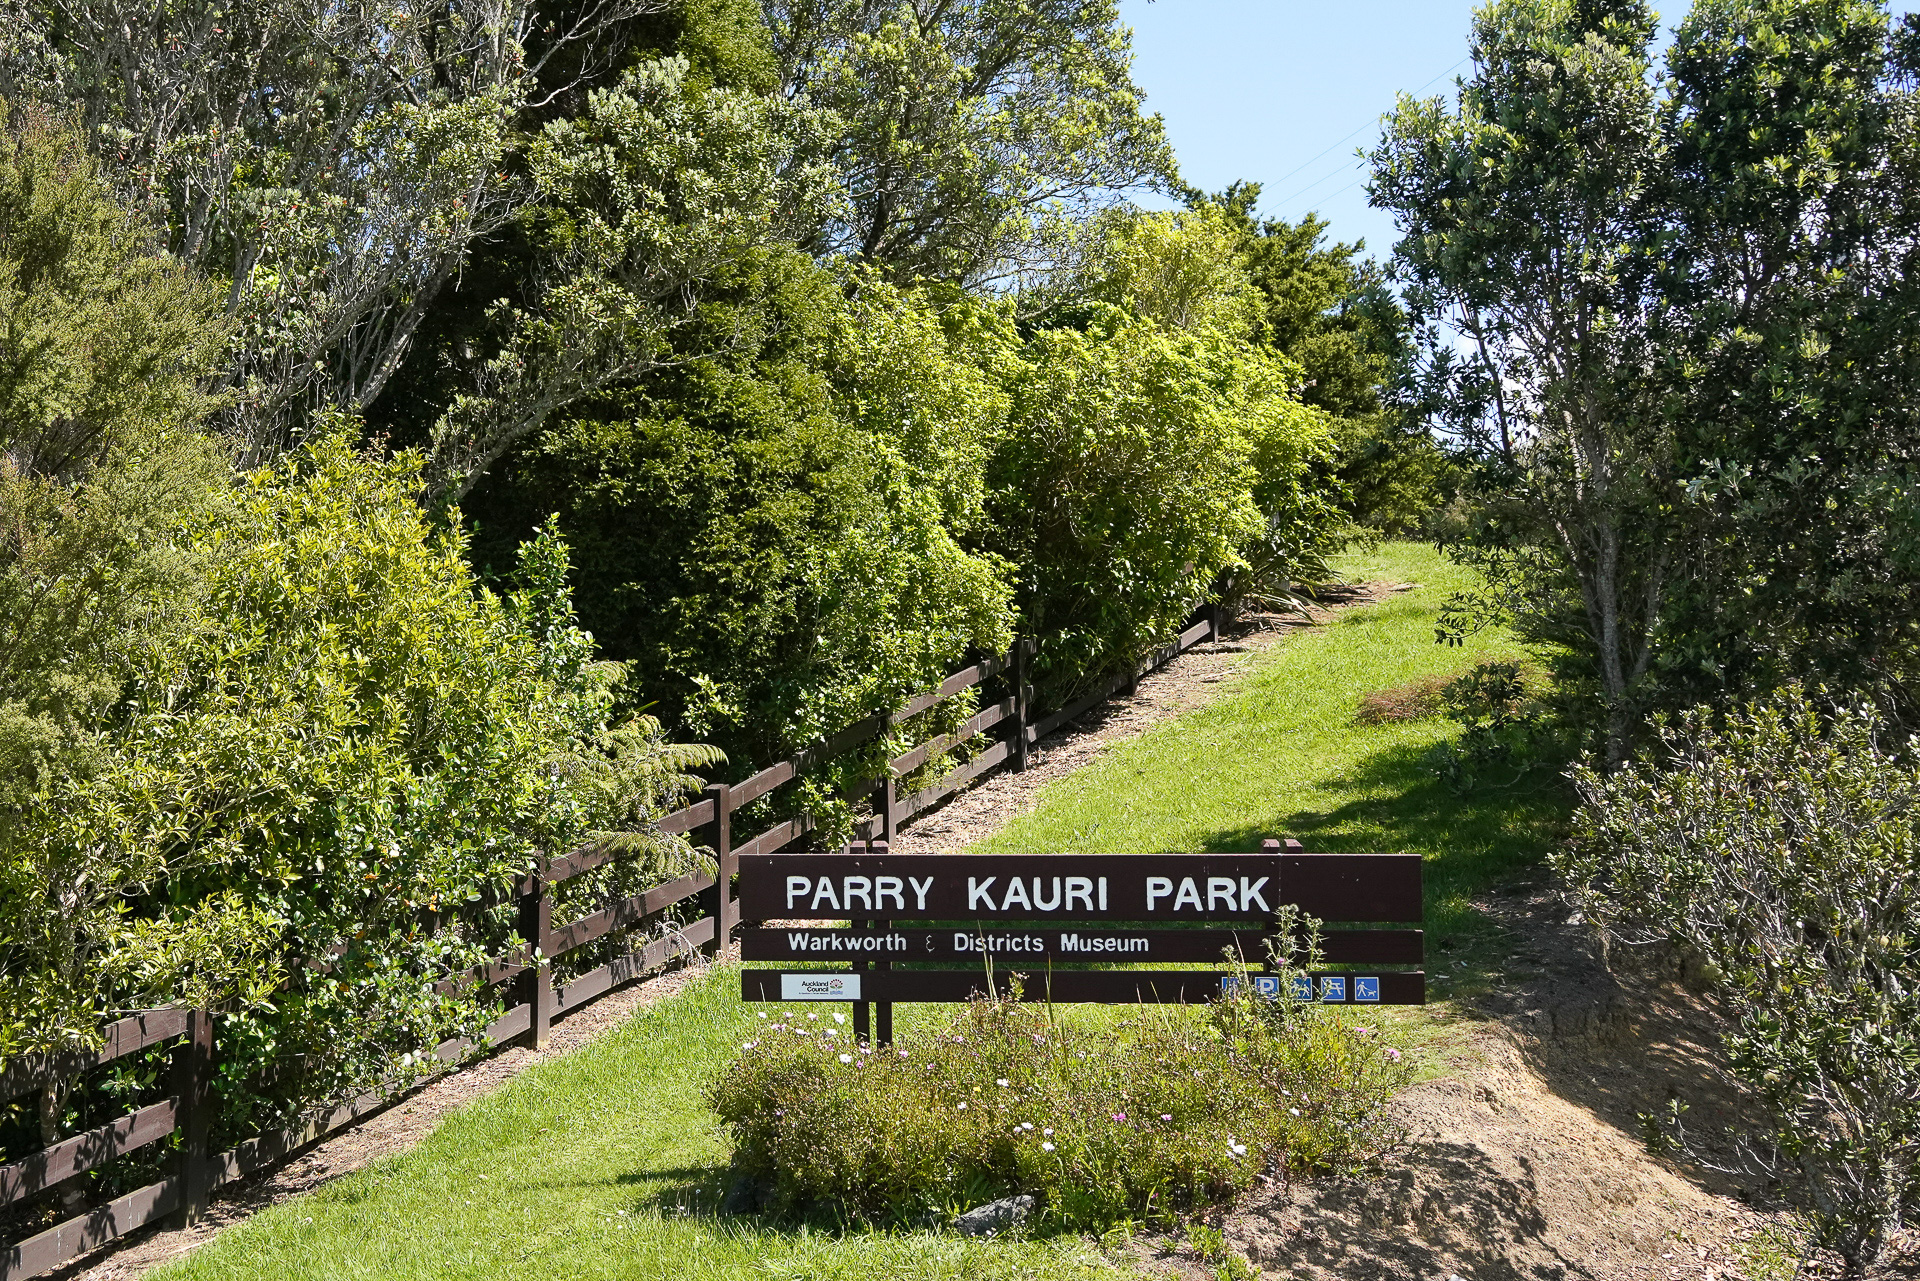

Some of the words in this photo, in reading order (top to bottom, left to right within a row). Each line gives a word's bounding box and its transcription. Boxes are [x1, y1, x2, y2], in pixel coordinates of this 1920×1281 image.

[787, 876, 933, 911] PARRY
[968, 876, 1108, 912] KAURI
[1146, 876, 1270, 912] PARK
[788, 933, 907, 951] Warkworth
[954, 933, 1044, 952] Districts
[1061, 933, 1149, 952] Museum
